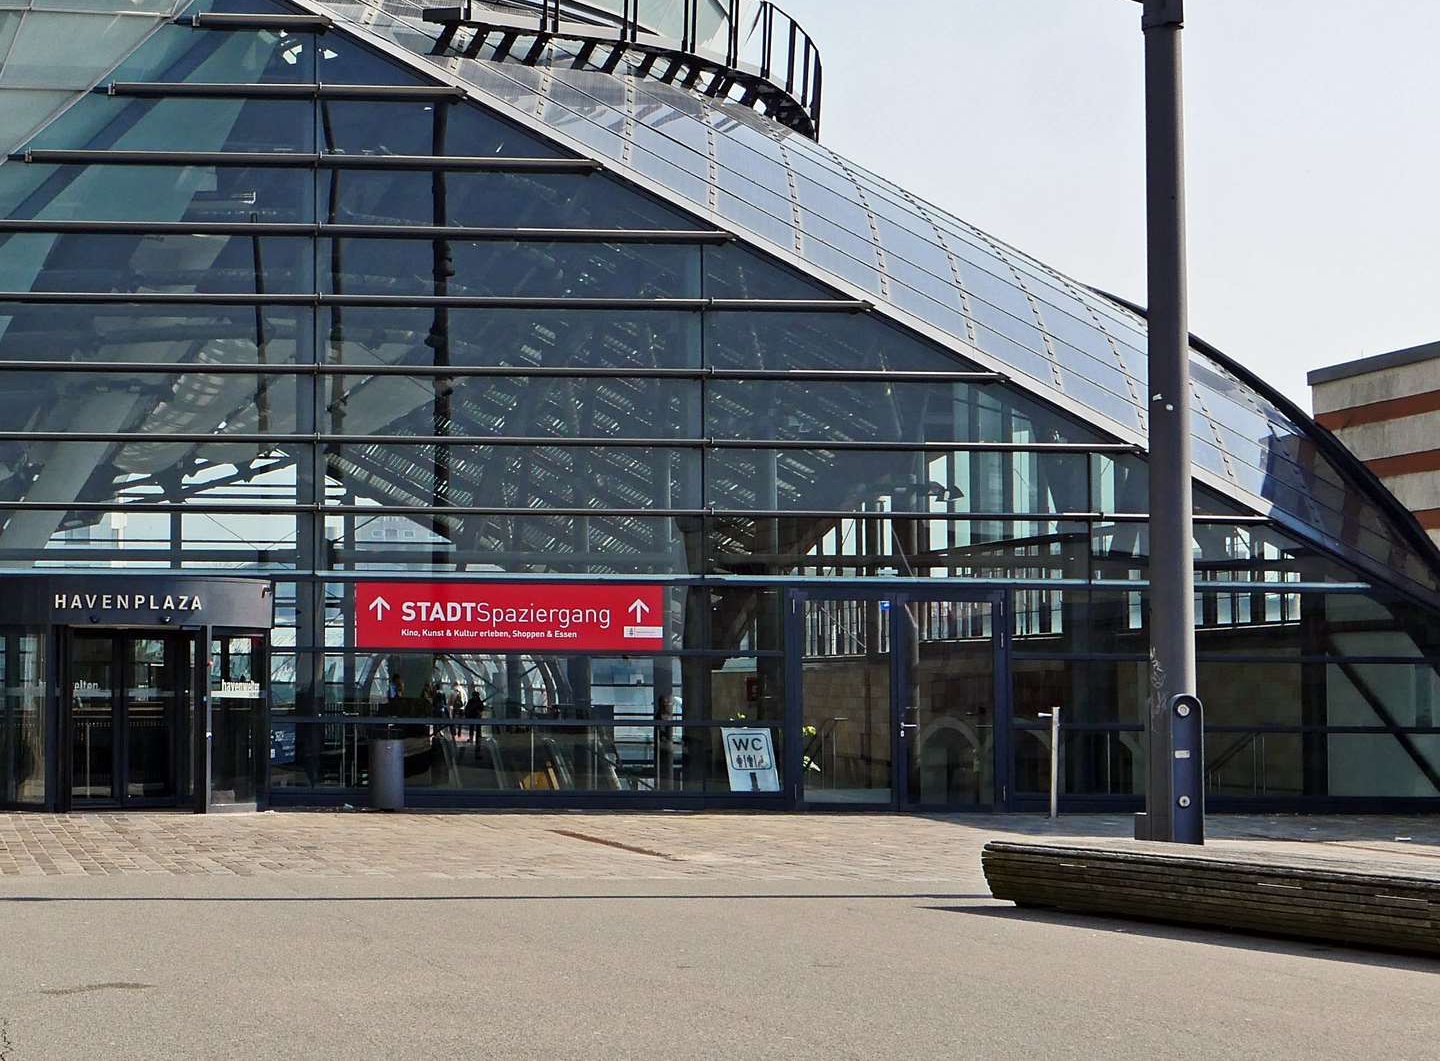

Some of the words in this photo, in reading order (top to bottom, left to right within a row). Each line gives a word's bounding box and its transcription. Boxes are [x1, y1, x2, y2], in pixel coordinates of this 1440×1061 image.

[54, 594, 203, 611] HAVENPLAZA
[401, 601, 611, 628] STADTSpaziergang
[401, 629, 421, 637] Kino,
[422, 629, 444, 637] Kunst
[445, 629, 452, 637] &
[454, 629, 478, 637] Kultur
[479, 630, 511, 638] erleben,
[512, 630, 545, 639] Shoppen
[546, 630, 552, 638] &
[554, 630, 577, 638] Essen
[73, 679, 99, 690] elten
[732, 738, 763, 751] WC
